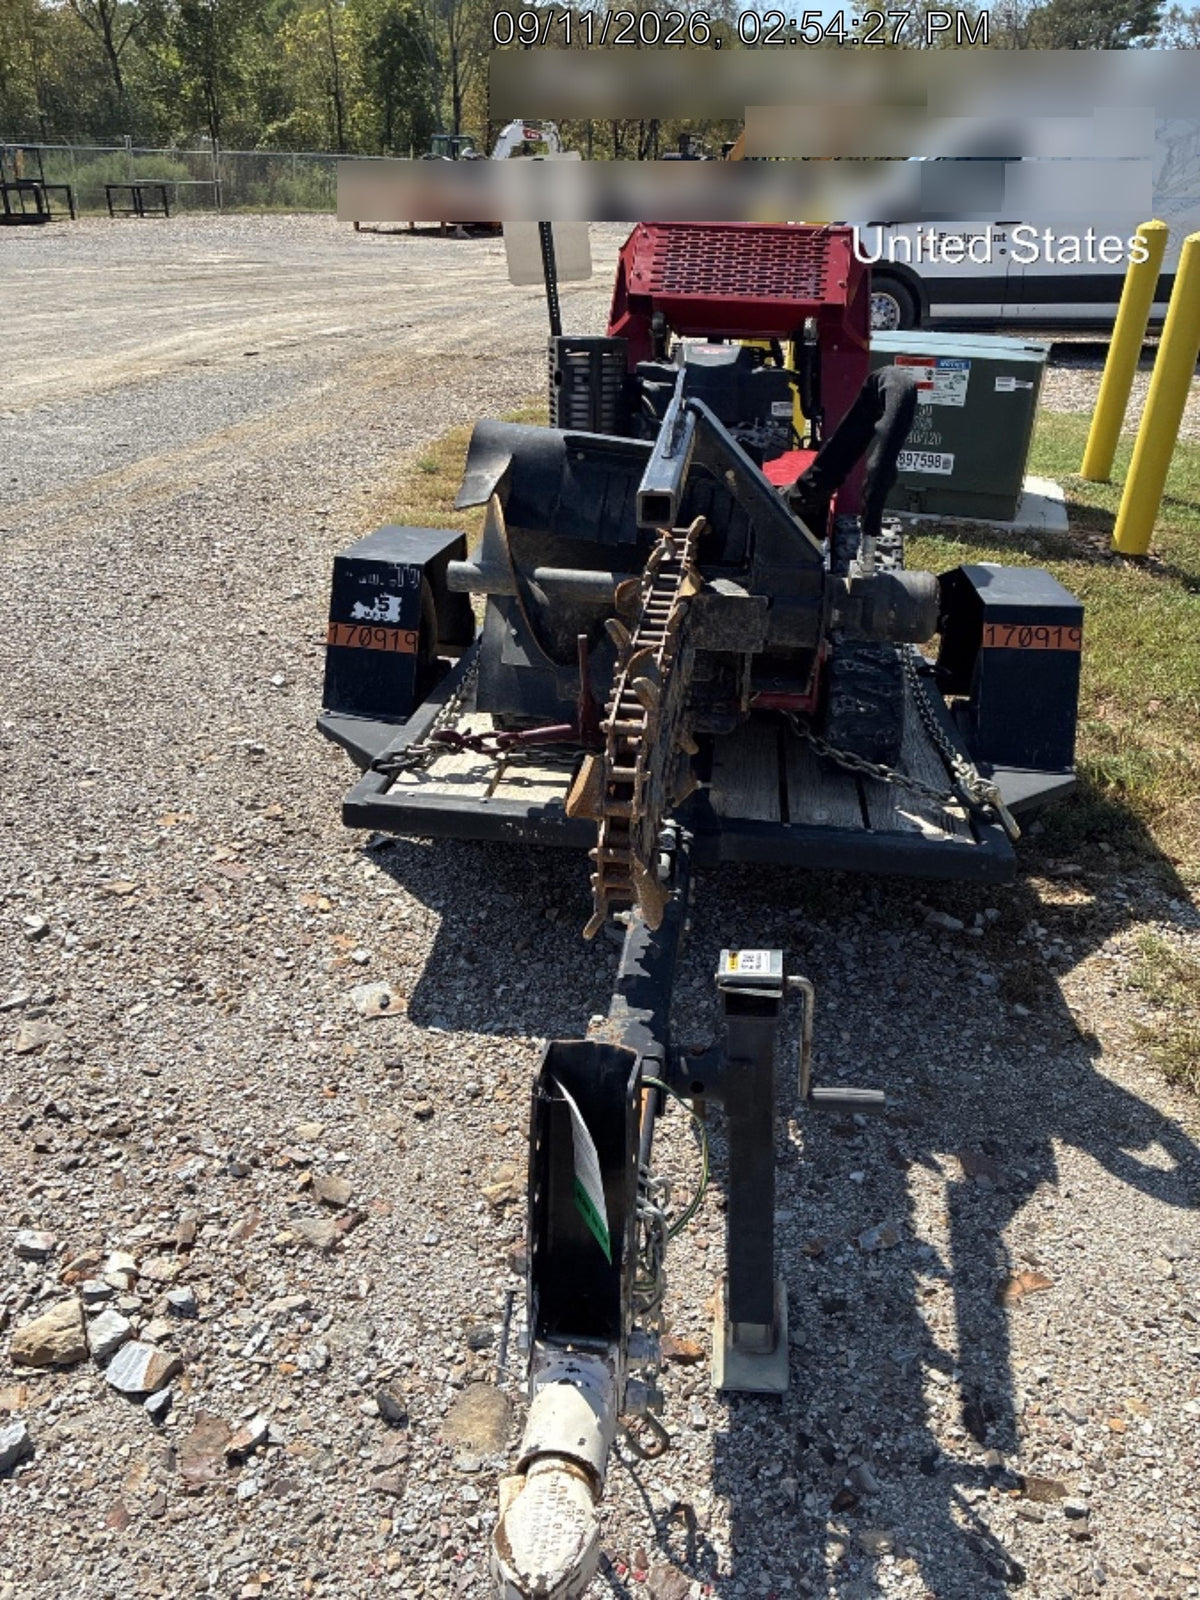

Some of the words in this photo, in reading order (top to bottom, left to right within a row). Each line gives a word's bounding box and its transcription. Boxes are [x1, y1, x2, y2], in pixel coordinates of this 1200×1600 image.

[938, 232, 1007, 245] Euipmnt
[329, 624, 418, 652] 170919
[985, 626, 1081, 649] 170919
